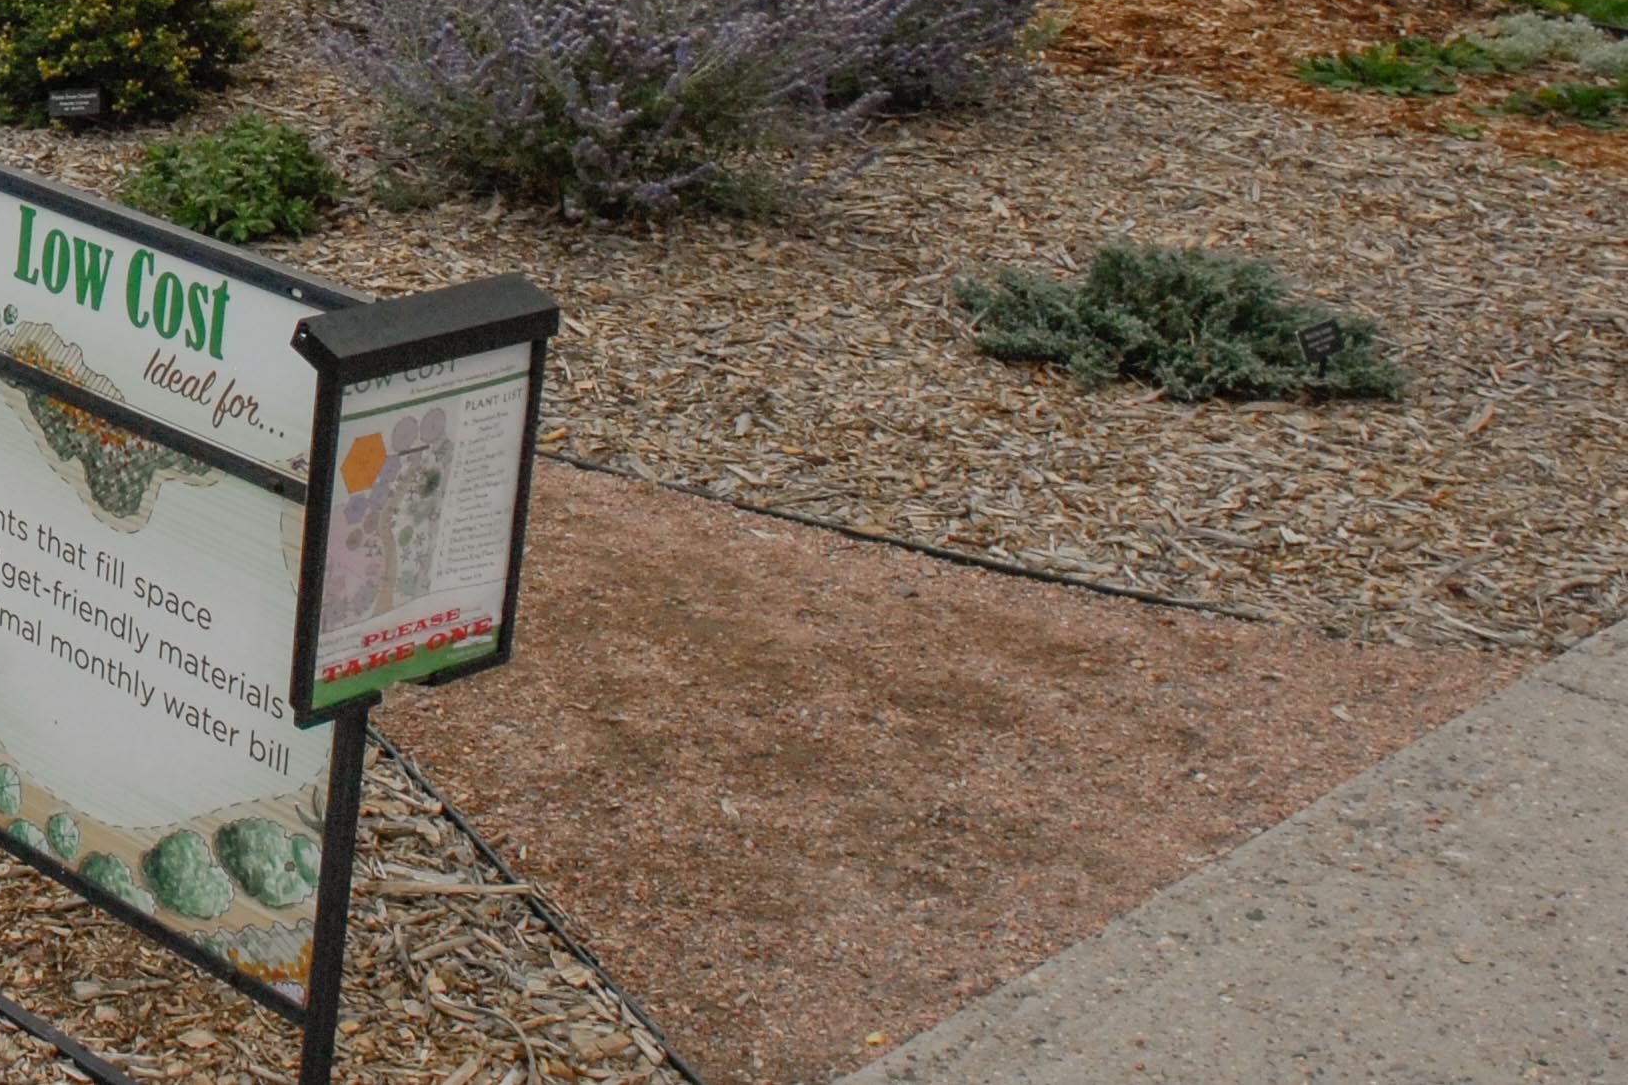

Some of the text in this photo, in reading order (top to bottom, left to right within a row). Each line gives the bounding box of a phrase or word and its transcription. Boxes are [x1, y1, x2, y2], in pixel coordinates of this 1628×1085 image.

[143, 347, 217, 406] Ideal
[465, 389, 522, 411] PLANT LIST
[37, 524, 88, 571] that
[96, 551, 125, 589] fill
[133, 576, 212, 631] space
[322, 641, 416, 684] TAKE
[425, 615, 492, 652] ONE
[362, 607, 461, 648] PLEASE
[50, 634, 156, 708] monthly
[163, 692, 241, 747] water
[249, 729, 290, 776] bill
[159, 639, 284, 719] materials
